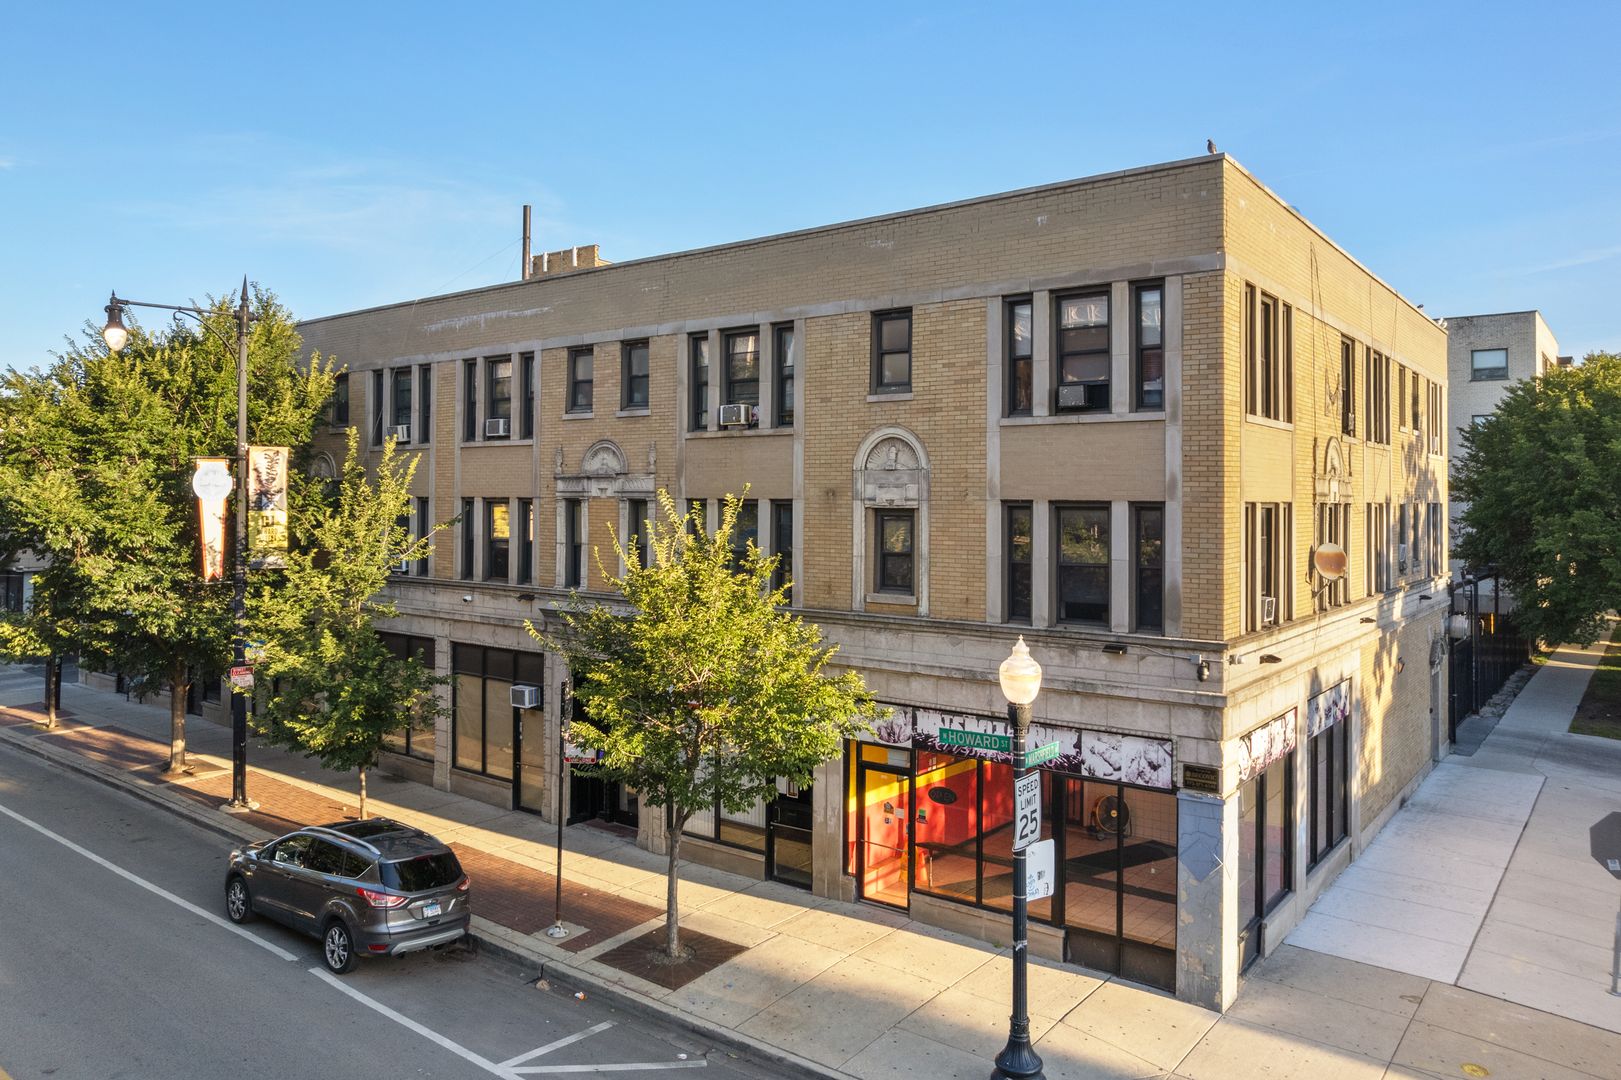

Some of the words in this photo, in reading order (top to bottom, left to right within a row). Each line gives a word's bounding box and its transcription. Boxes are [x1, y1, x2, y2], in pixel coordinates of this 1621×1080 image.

[948, 730, 1000, 749] HOWARD
[1001, 739, 1009, 748] ST
[1017, 779, 1039, 797] SPEED
[1020, 793, 1037, 811] LIMIT
[1019, 808, 1038, 841] 25
